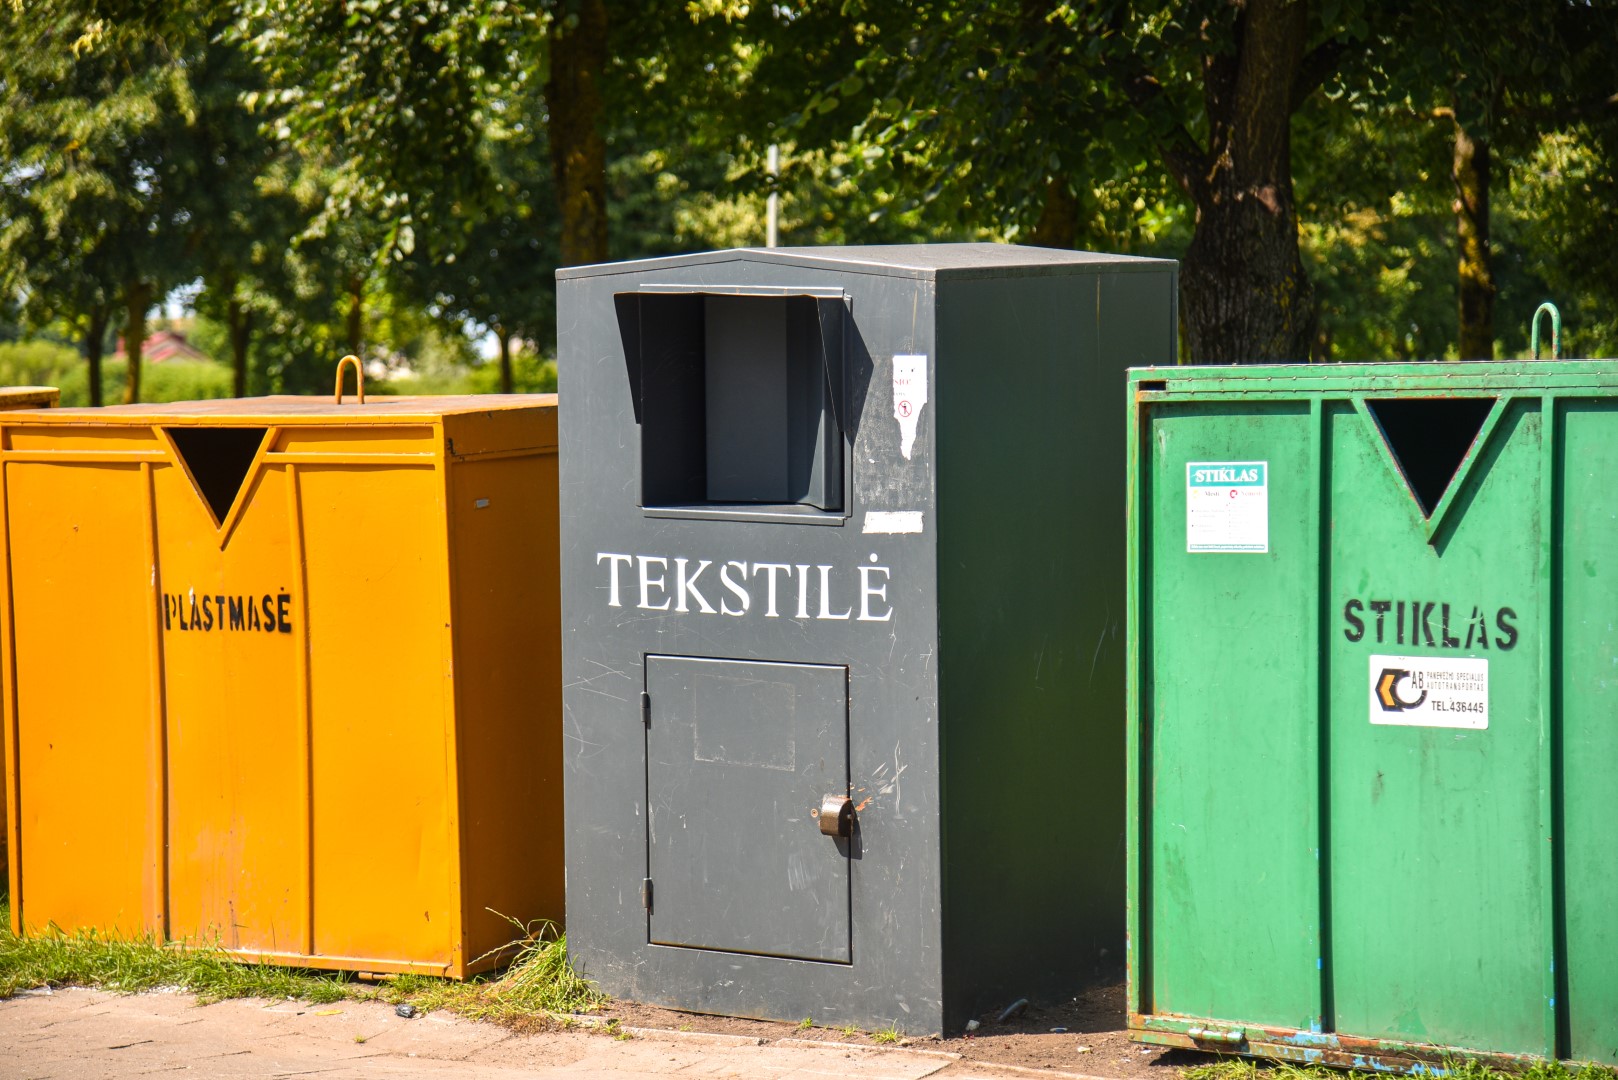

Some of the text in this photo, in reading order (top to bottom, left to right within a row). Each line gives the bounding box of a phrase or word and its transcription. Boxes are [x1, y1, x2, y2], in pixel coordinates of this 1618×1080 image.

[1195, 469, 1258, 482] STIKLAS
[596, 552, 893, 622] TEKSTILĖ
[164, 587, 292, 633] PLASTMASĖ
[1343, 598, 1519, 652] STIKLAS
[1411, 671, 1424, 690] AB
[1427, 681, 1484, 692] AUTOTRANSPORTAS
